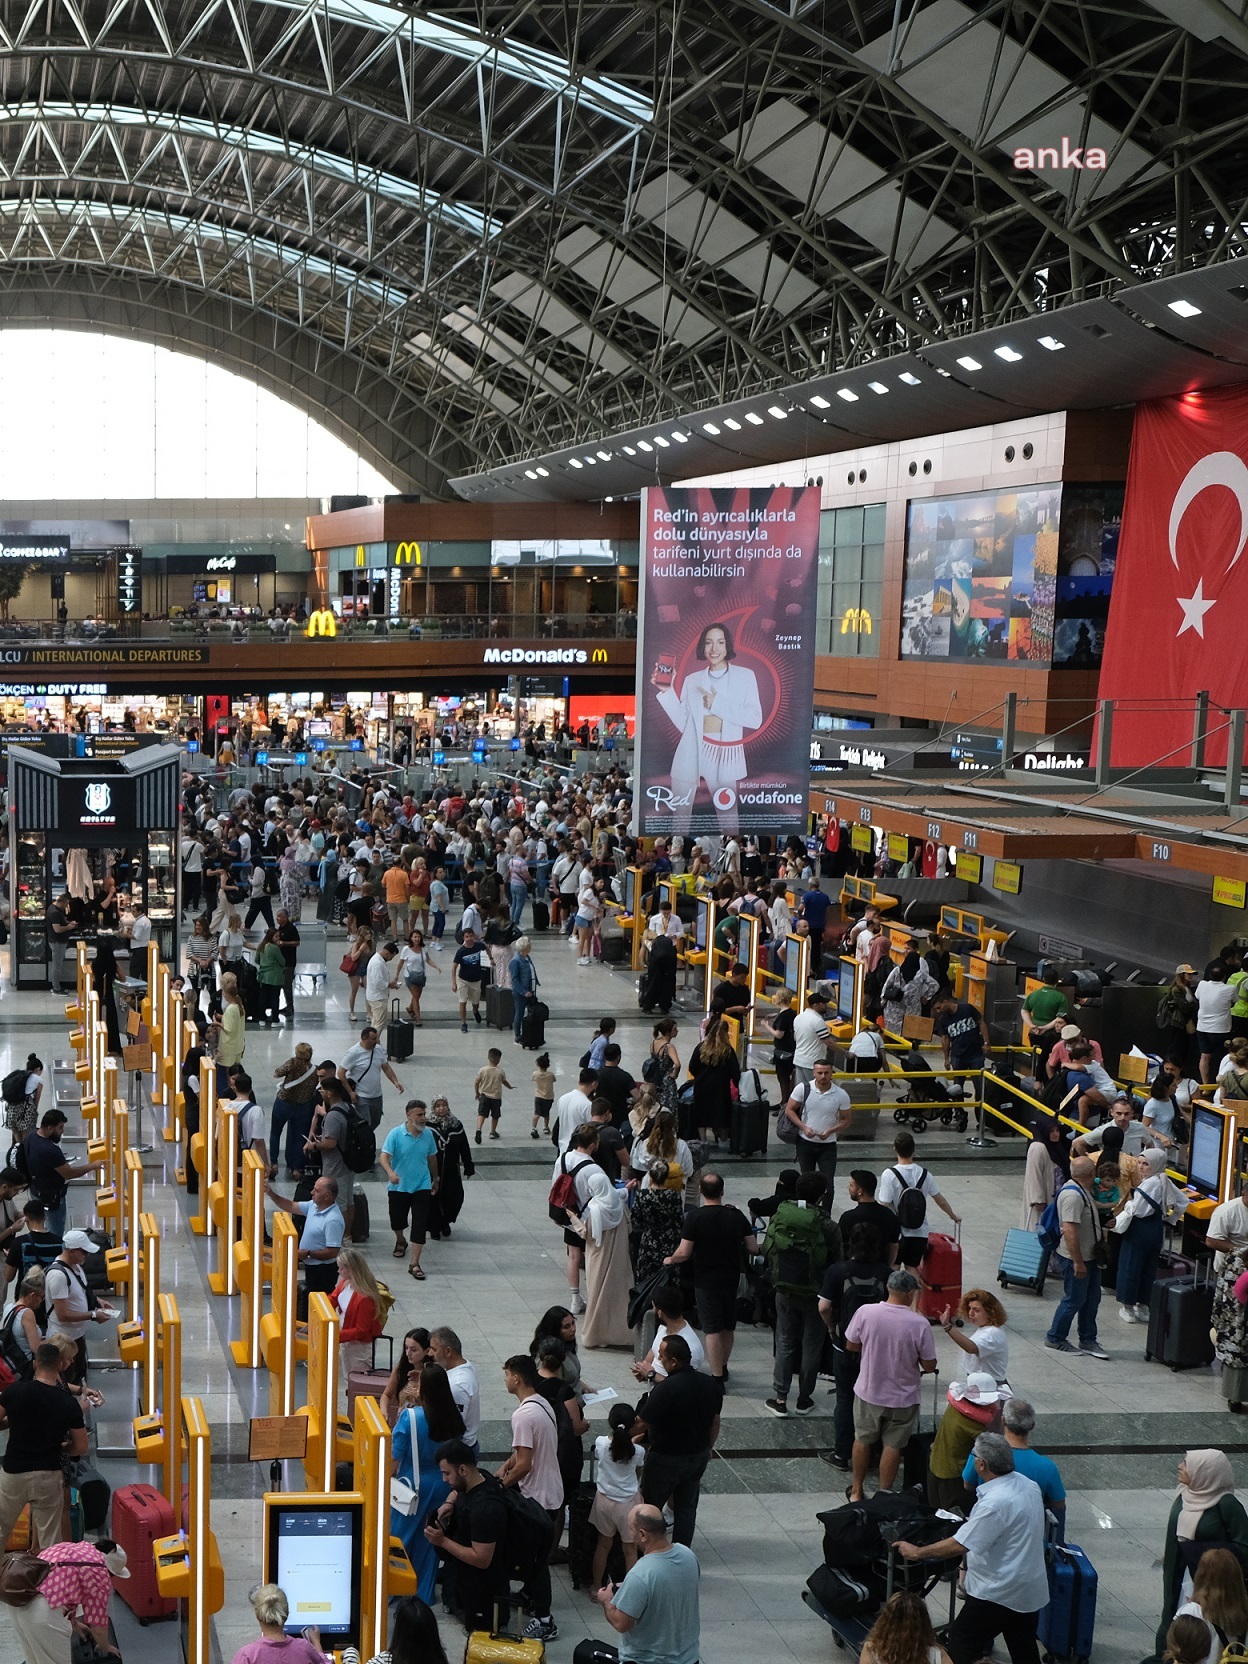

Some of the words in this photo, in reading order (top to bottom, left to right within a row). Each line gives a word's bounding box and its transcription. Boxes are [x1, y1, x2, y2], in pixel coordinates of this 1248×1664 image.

[653, 509, 698, 523] Red'in
[702, 508, 796, 526] ayrıcalıklarla
[653, 527, 686, 541] dolu
[690, 527, 768, 544] dünyasıyla
[653, 545, 699, 559] tarifeni
[703, 546, 732, 562] yurt
[735, 545, 782, 562] dışında
[785, 545, 802, 558] da
[652, 563, 745, 577] kullanabilirsin
[775, 634, 802, 642] Zeynep
[32, 650, 126, 663] INTERNATIONAL
[128, 649, 202, 662] DEPARTURES
[483, 648, 588, 663] McDonald's
[47, 684, 78, 695] DUTY
[79, 684, 107, 694] FREE
[646, 785, 693, 812] Red
[739, 791, 803, 805] vodafone
[825, 800, 835, 812] F14
[860, 807, 871, 822] F13
[928, 823, 940, 839] F12
[964, 831, 976, 847] F11
[1152, 843, 1169, 860] F10
